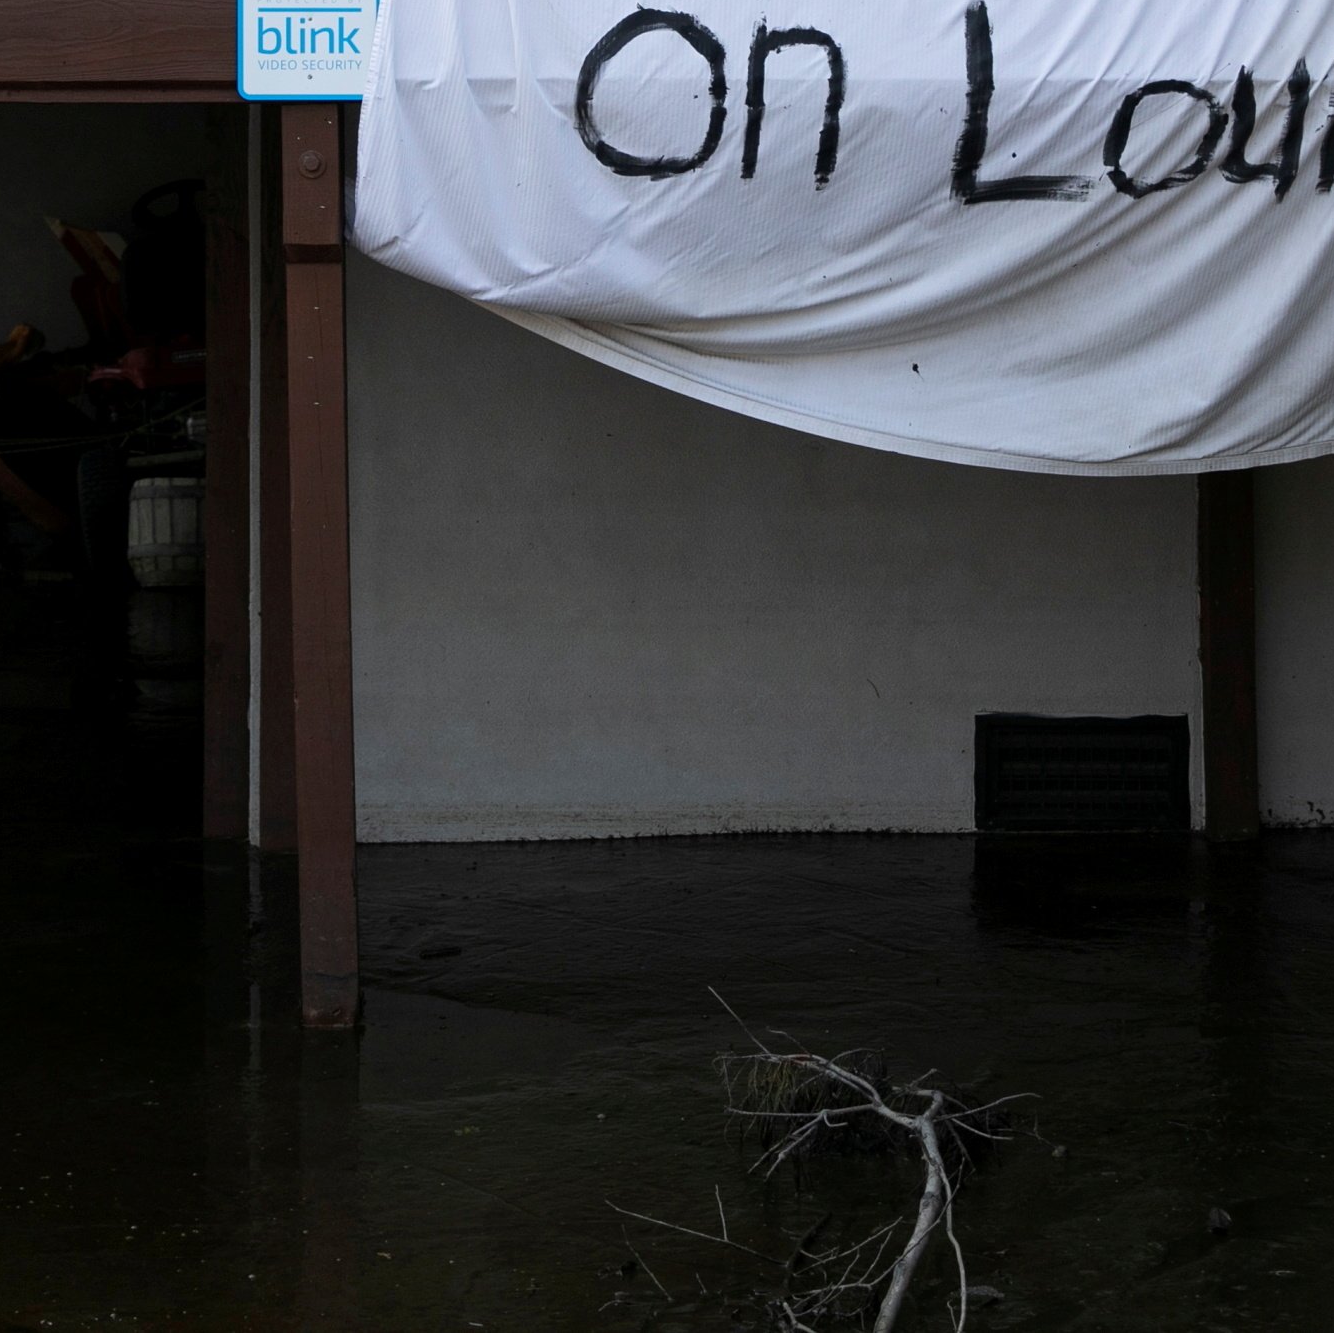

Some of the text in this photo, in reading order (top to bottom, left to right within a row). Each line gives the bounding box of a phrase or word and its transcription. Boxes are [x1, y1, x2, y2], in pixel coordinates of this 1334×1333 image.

[257, 17, 361, 55] blink
[257, 59, 362, 70] VIDEO SECURITY
[576, 2, 847, 191] on
